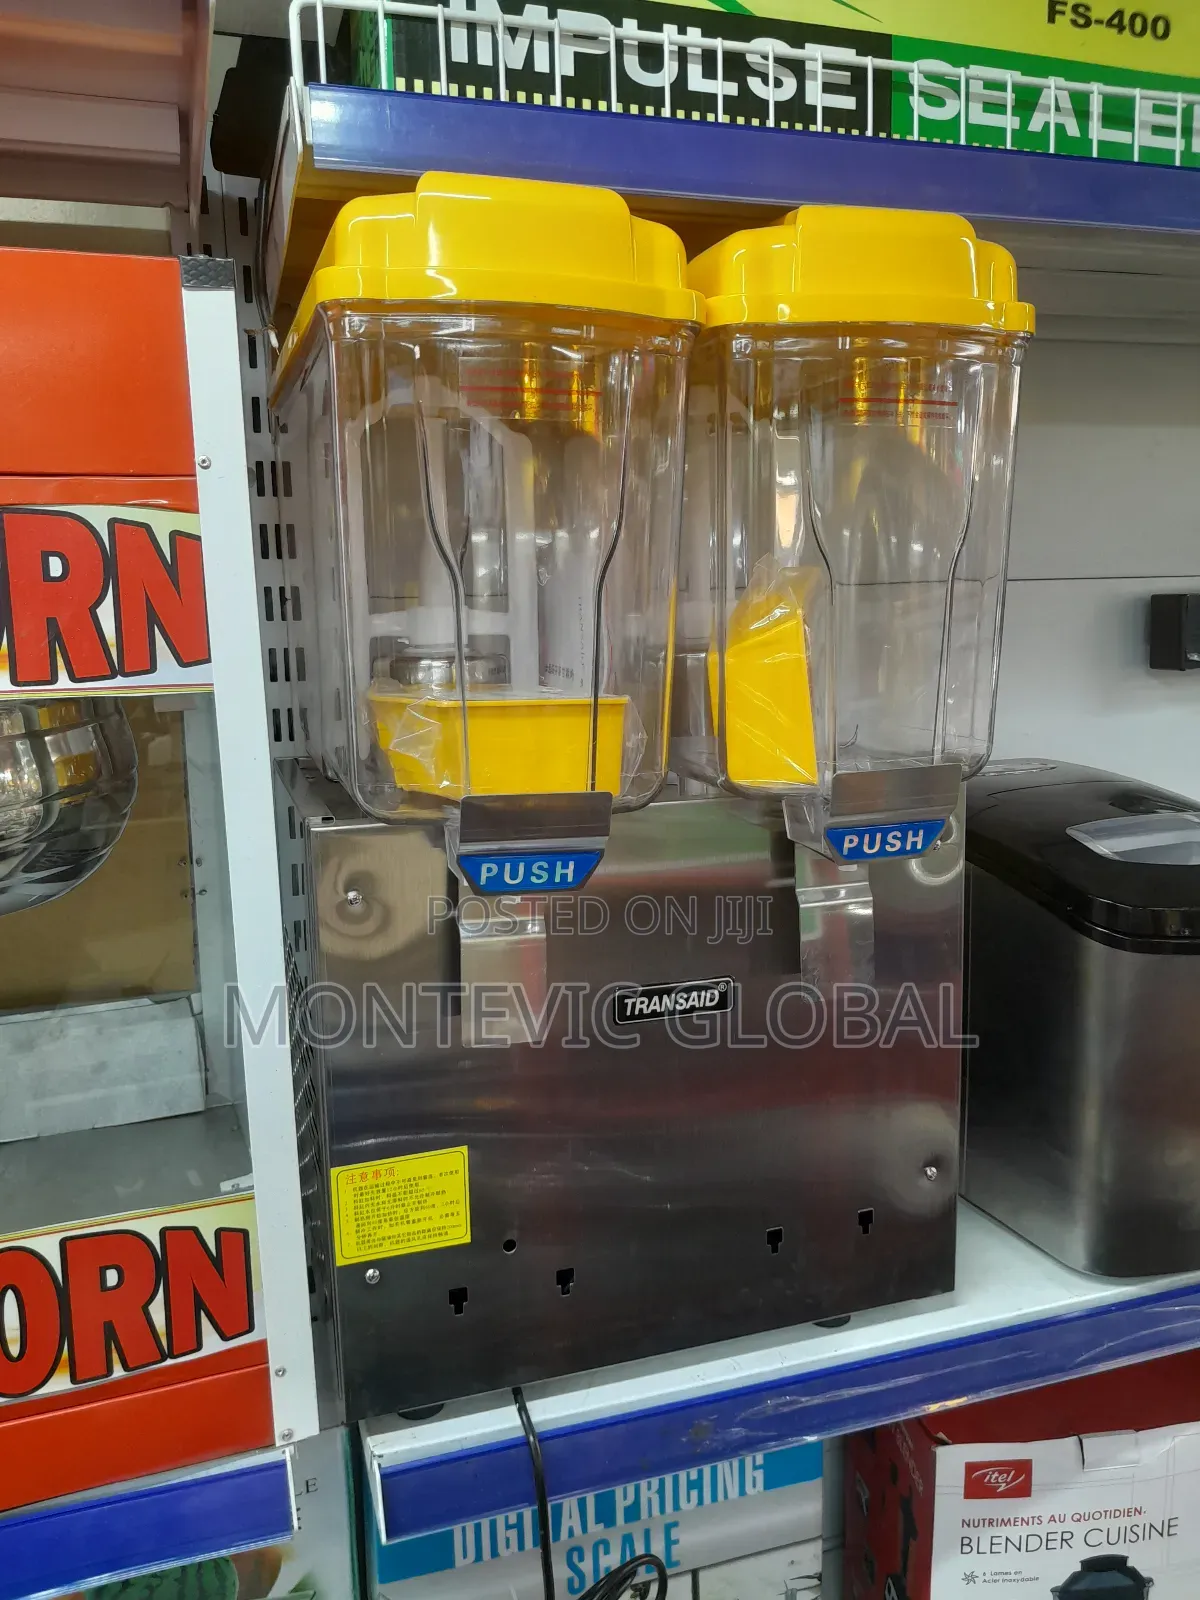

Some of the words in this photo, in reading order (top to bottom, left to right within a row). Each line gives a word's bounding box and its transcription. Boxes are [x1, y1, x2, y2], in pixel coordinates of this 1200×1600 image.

[1047, 0, 1171, 41] FS-400
[448, 0, 857, 111] IMPULSE
[842, 829, 926, 856] PUSH
[480, 861, 575, 885] PUSH
[624, 989, 720, 1016] TRANSAID
[984, 1470, 1016, 1484] itel
[454, 1493, 604, 1567] DIGIAL
[615, 1453, 764, 1527] PRICING
[961, 1515, 1043, 1529] NUTRIMENTS
[1047, 1512, 1067, 1525] AU
[960, 1530, 1075, 1555] BLENDER
[1083, 1516, 1180, 1548] CUISINE
[566, 1520, 681, 1596] SCALE
